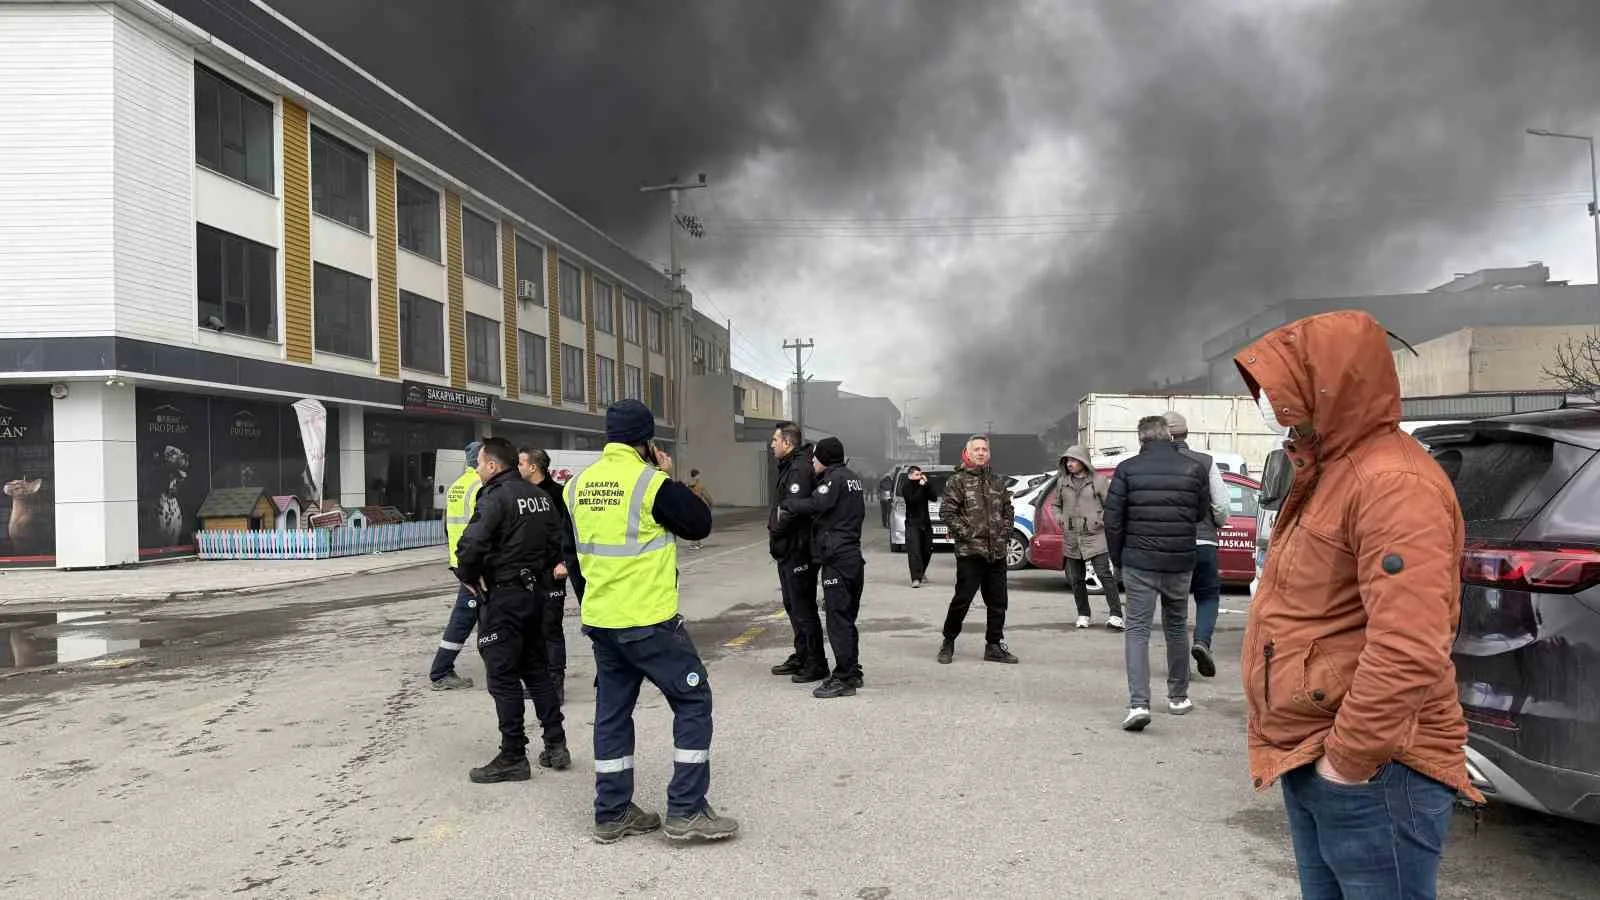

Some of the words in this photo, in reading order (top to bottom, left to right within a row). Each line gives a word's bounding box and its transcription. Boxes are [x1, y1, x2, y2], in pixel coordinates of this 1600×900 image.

[427, 387, 455, 402] SAKARYA
[455, 392, 465, 404] PET
[466, 394, 488, 409] MARKET
[585, 481, 619, 489] SAKARYA
[1218, 539, 1255, 547] BAŞKANL
